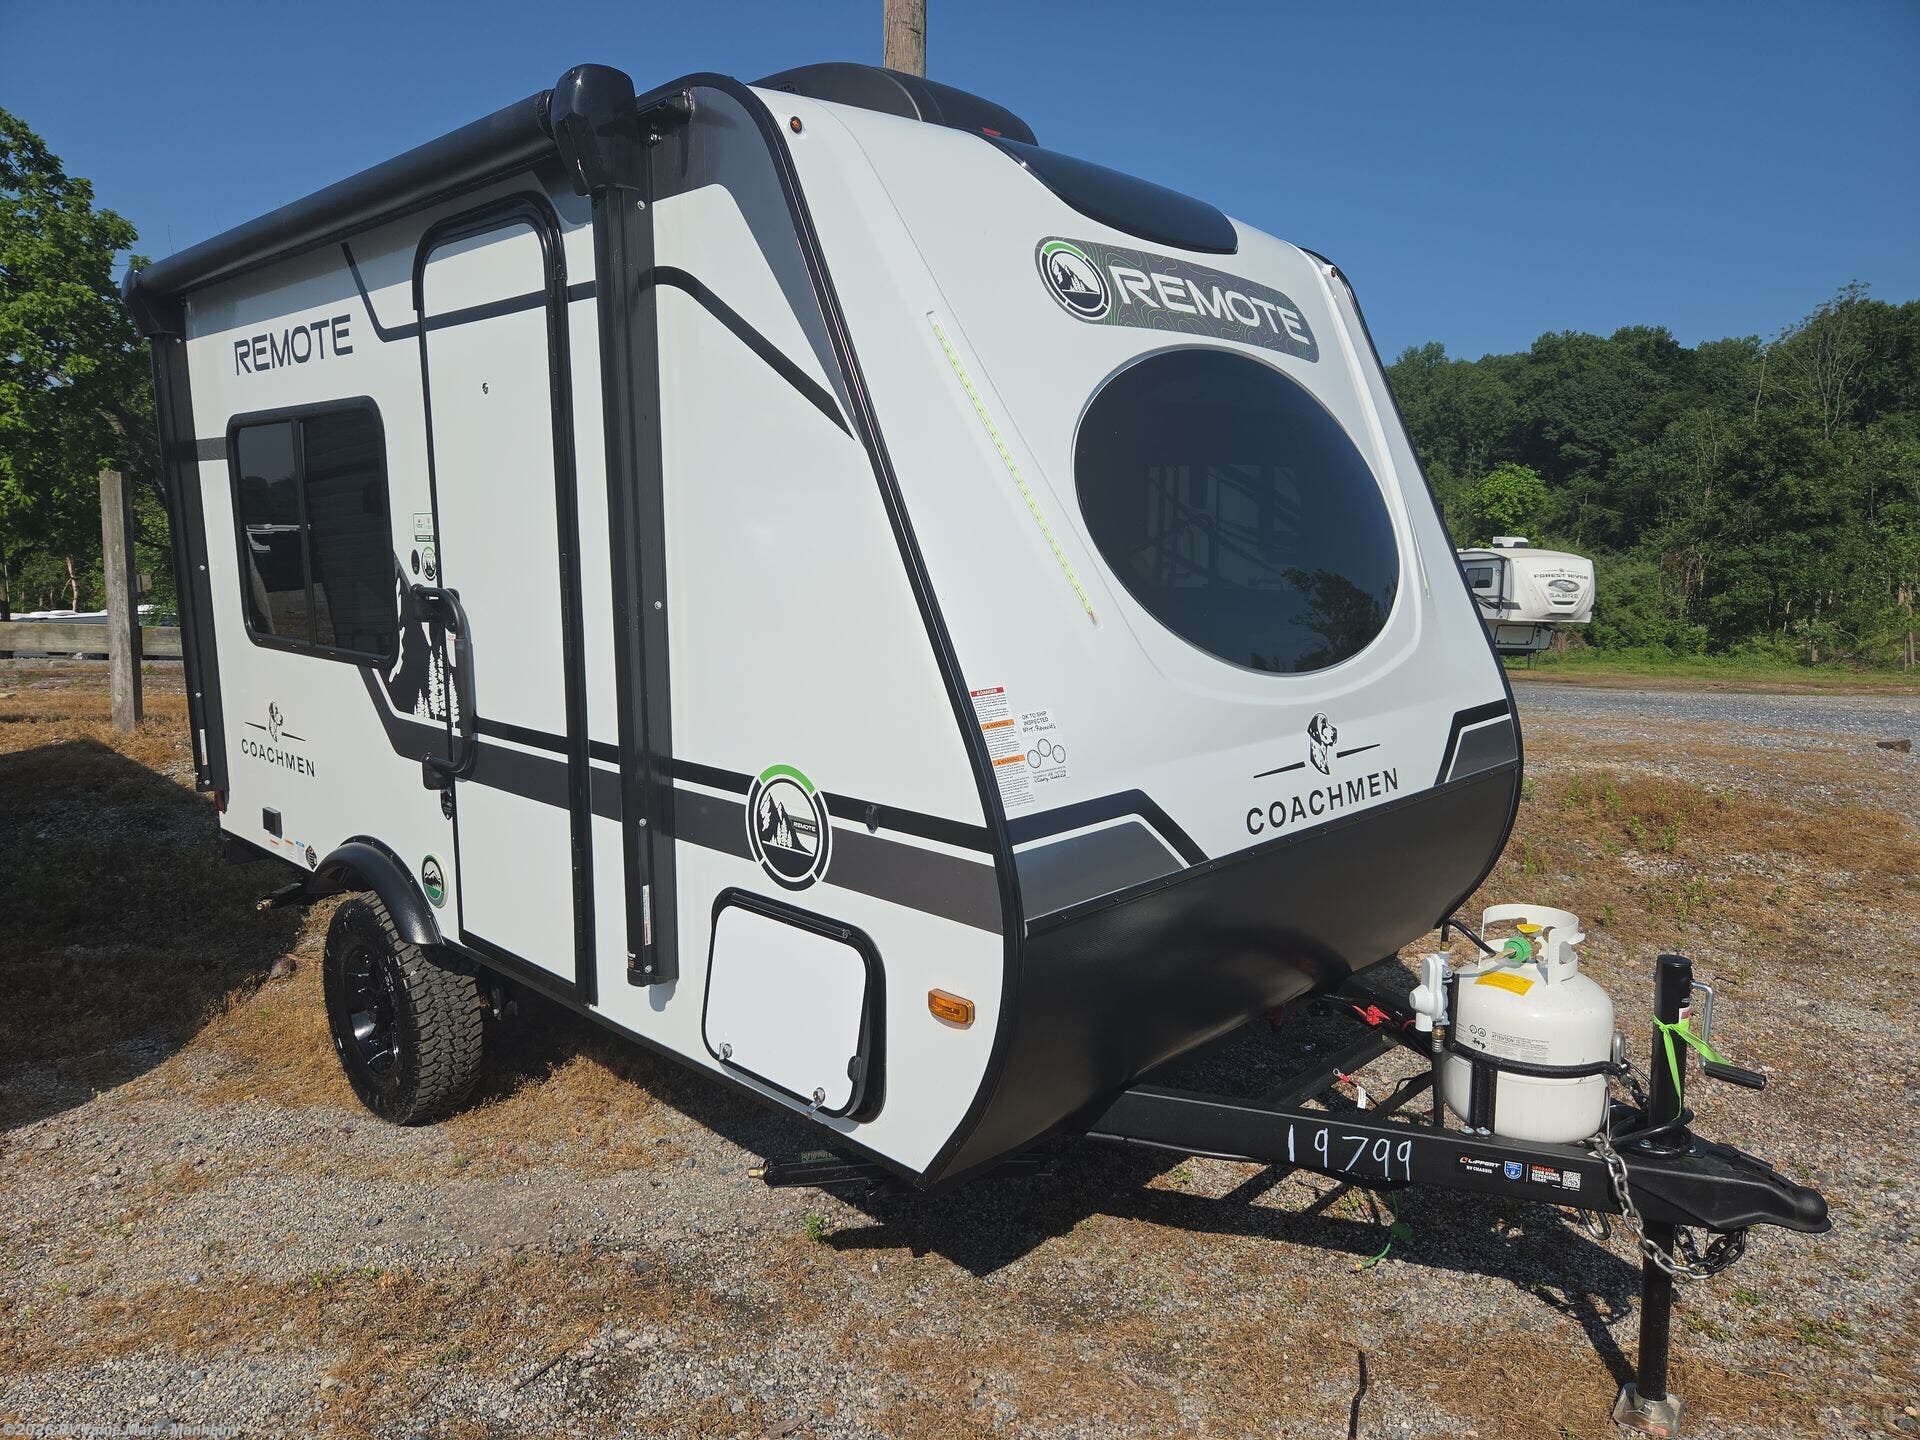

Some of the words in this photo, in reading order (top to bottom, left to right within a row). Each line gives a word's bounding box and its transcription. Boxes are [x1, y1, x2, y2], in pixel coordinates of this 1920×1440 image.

[1108, 264, 1311, 346] REMOTE
[234, 313, 353, 376] REMOTE
[241, 738, 315, 778] COACHMEN
[793, 821, 817, 833] REMOTE
[1246, 767, 1399, 836] COACHMEN
[1287, 1124, 1412, 1182] 19799
[1472, 1166, 1493, 1174] CHASSIS
